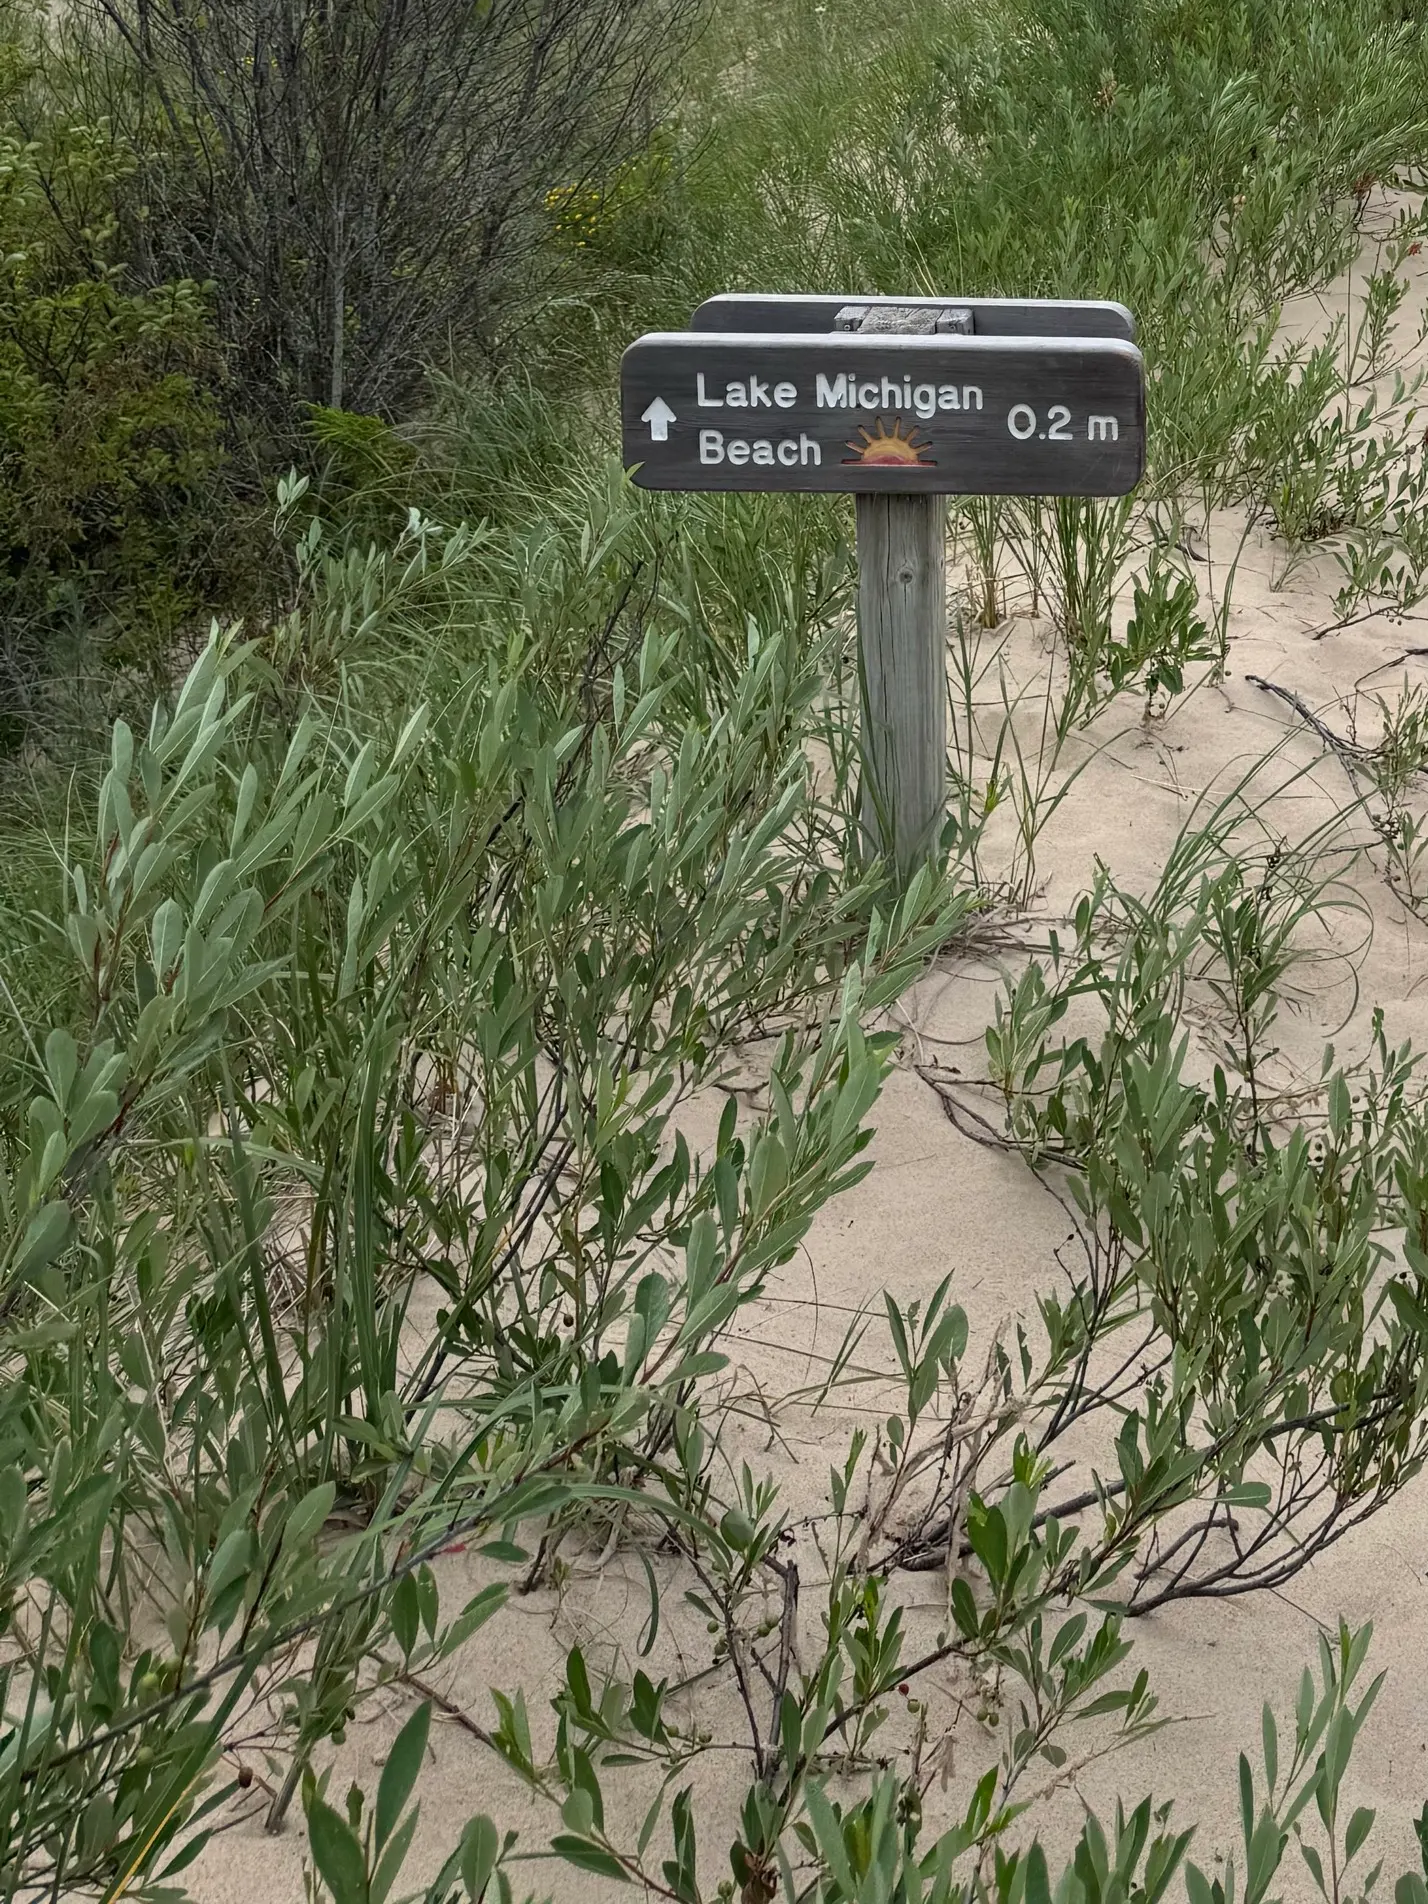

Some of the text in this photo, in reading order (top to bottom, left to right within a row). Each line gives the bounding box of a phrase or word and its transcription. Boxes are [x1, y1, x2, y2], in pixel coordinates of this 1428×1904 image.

[696, 372, 984, 419] Lake Michigan
[1007, 403, 1119, 441] 0.2 m
[698, 429, 822, 466] Beach
